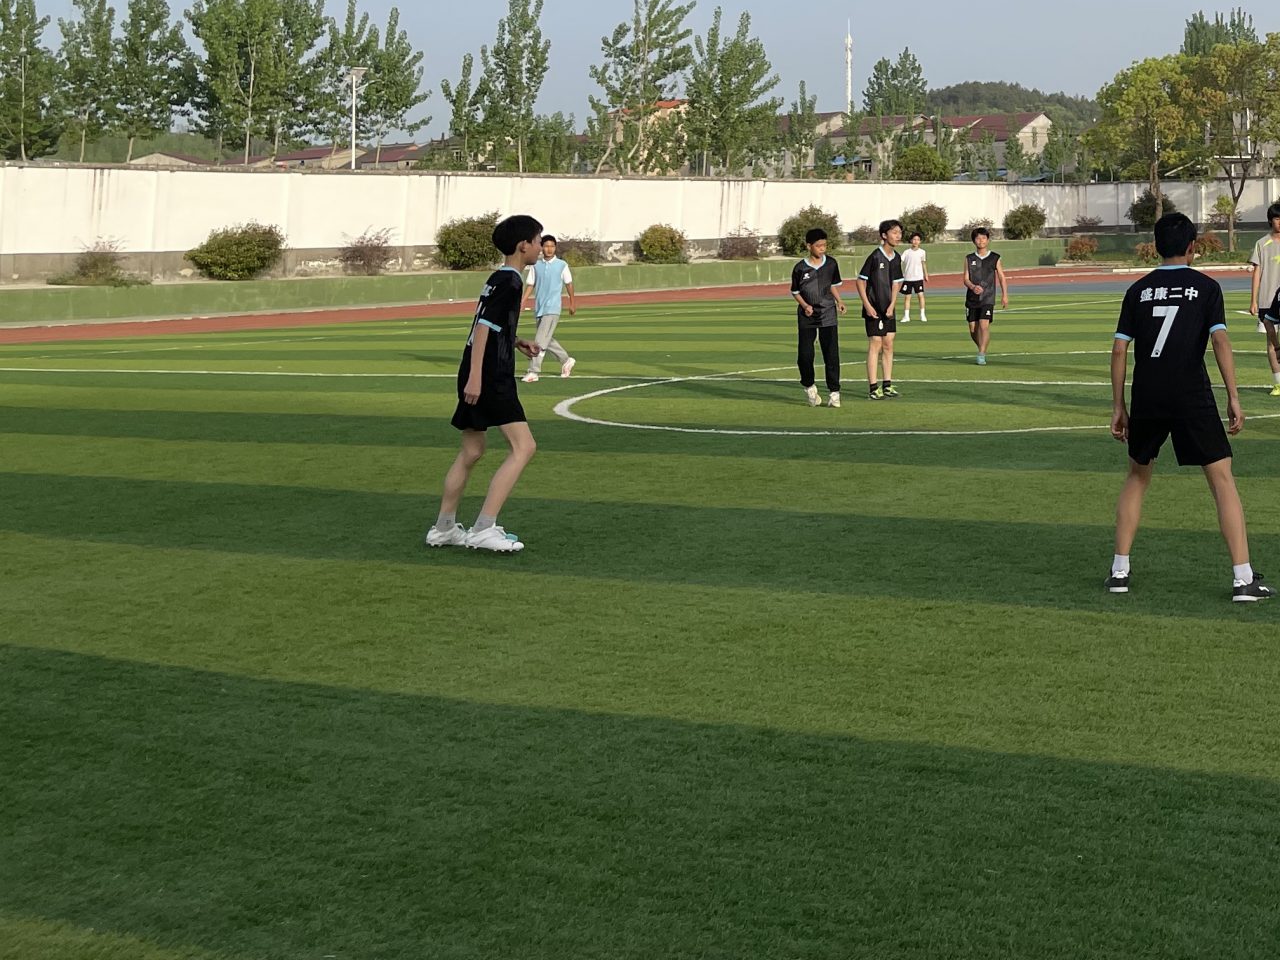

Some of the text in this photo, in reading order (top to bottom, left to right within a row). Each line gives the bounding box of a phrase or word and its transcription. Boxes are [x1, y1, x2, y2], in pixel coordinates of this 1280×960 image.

[1140, 286, 1199, 303] 盛康二中
[1151, 305, 1179, 357] 7
